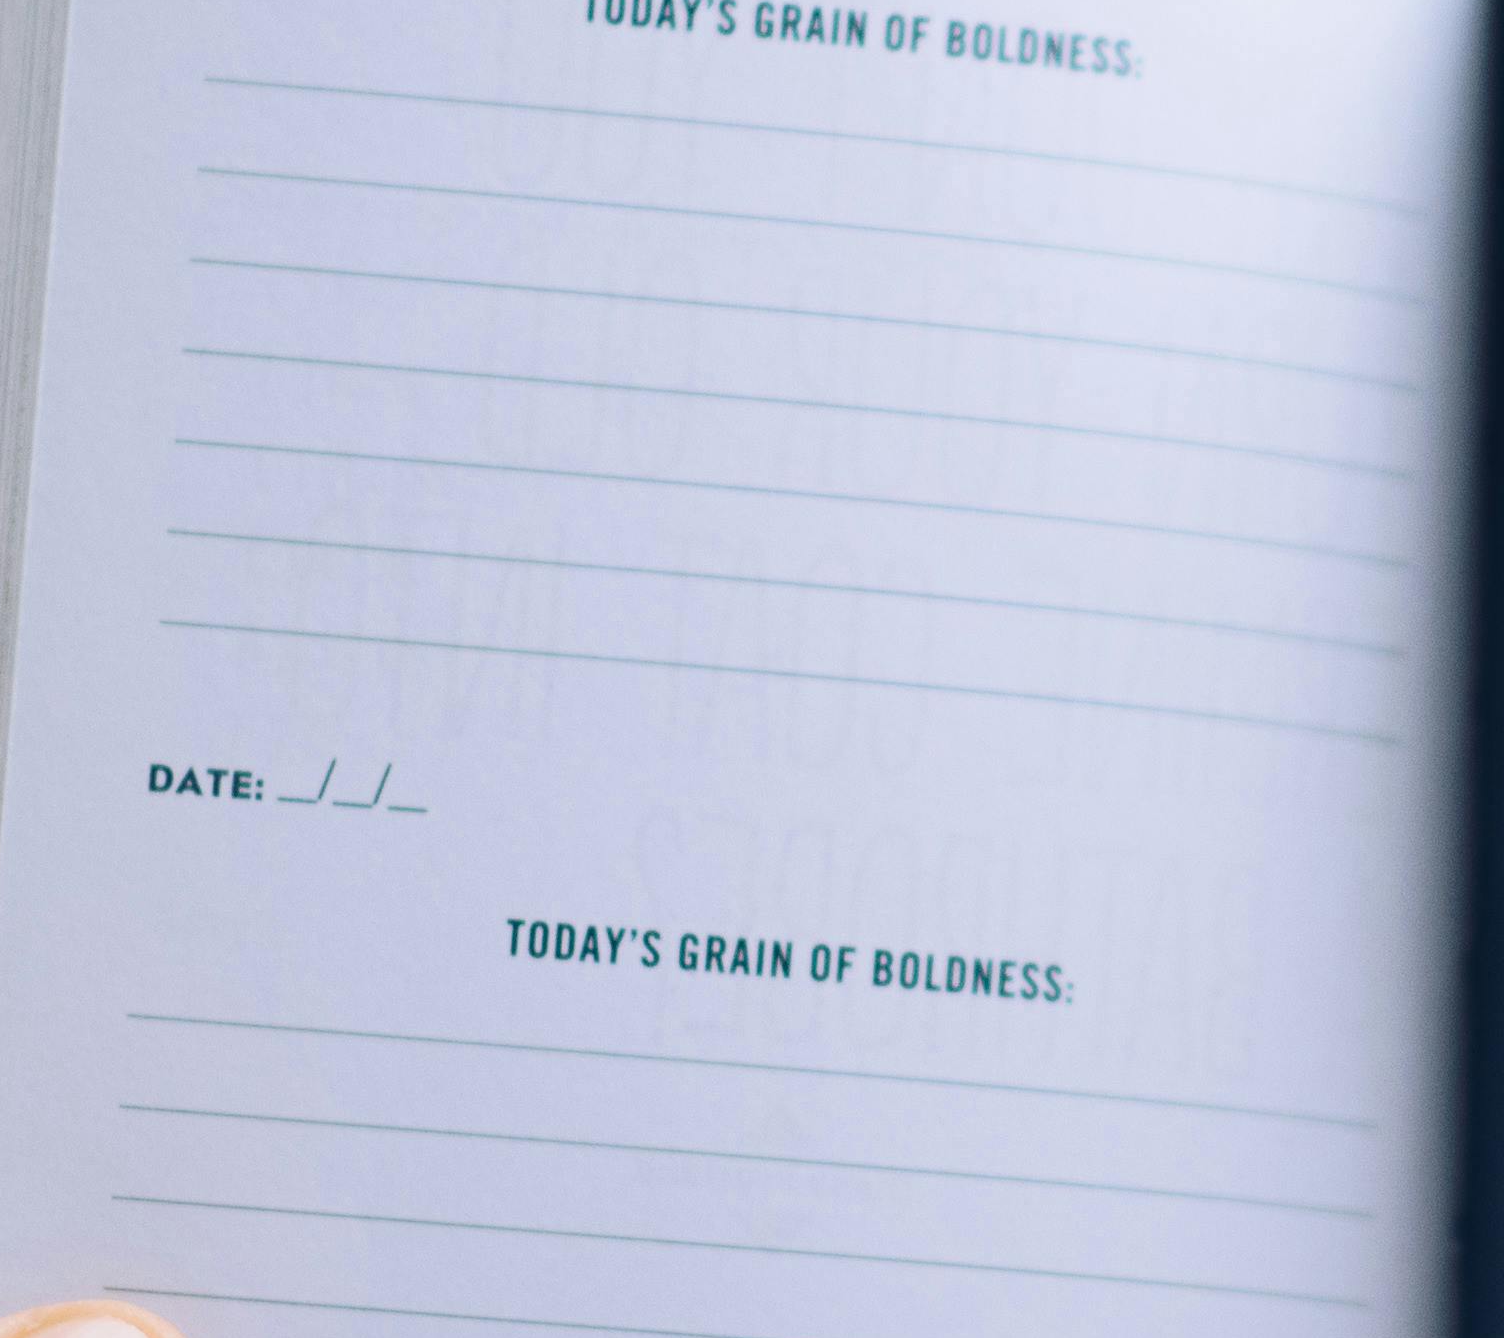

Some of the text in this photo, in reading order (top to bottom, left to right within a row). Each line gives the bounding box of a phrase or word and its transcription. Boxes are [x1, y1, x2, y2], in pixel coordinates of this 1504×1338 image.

[752, 0, 869, 49] GRAIN
[883, 12, 931, 54] OF
[941, 17, 1143, 79] BOLDNESS:
[147, 762, 265, 802] DATE:
[505, 917, 1075, 1005] TODAY'S GRAIN OF BOLDNESS:
